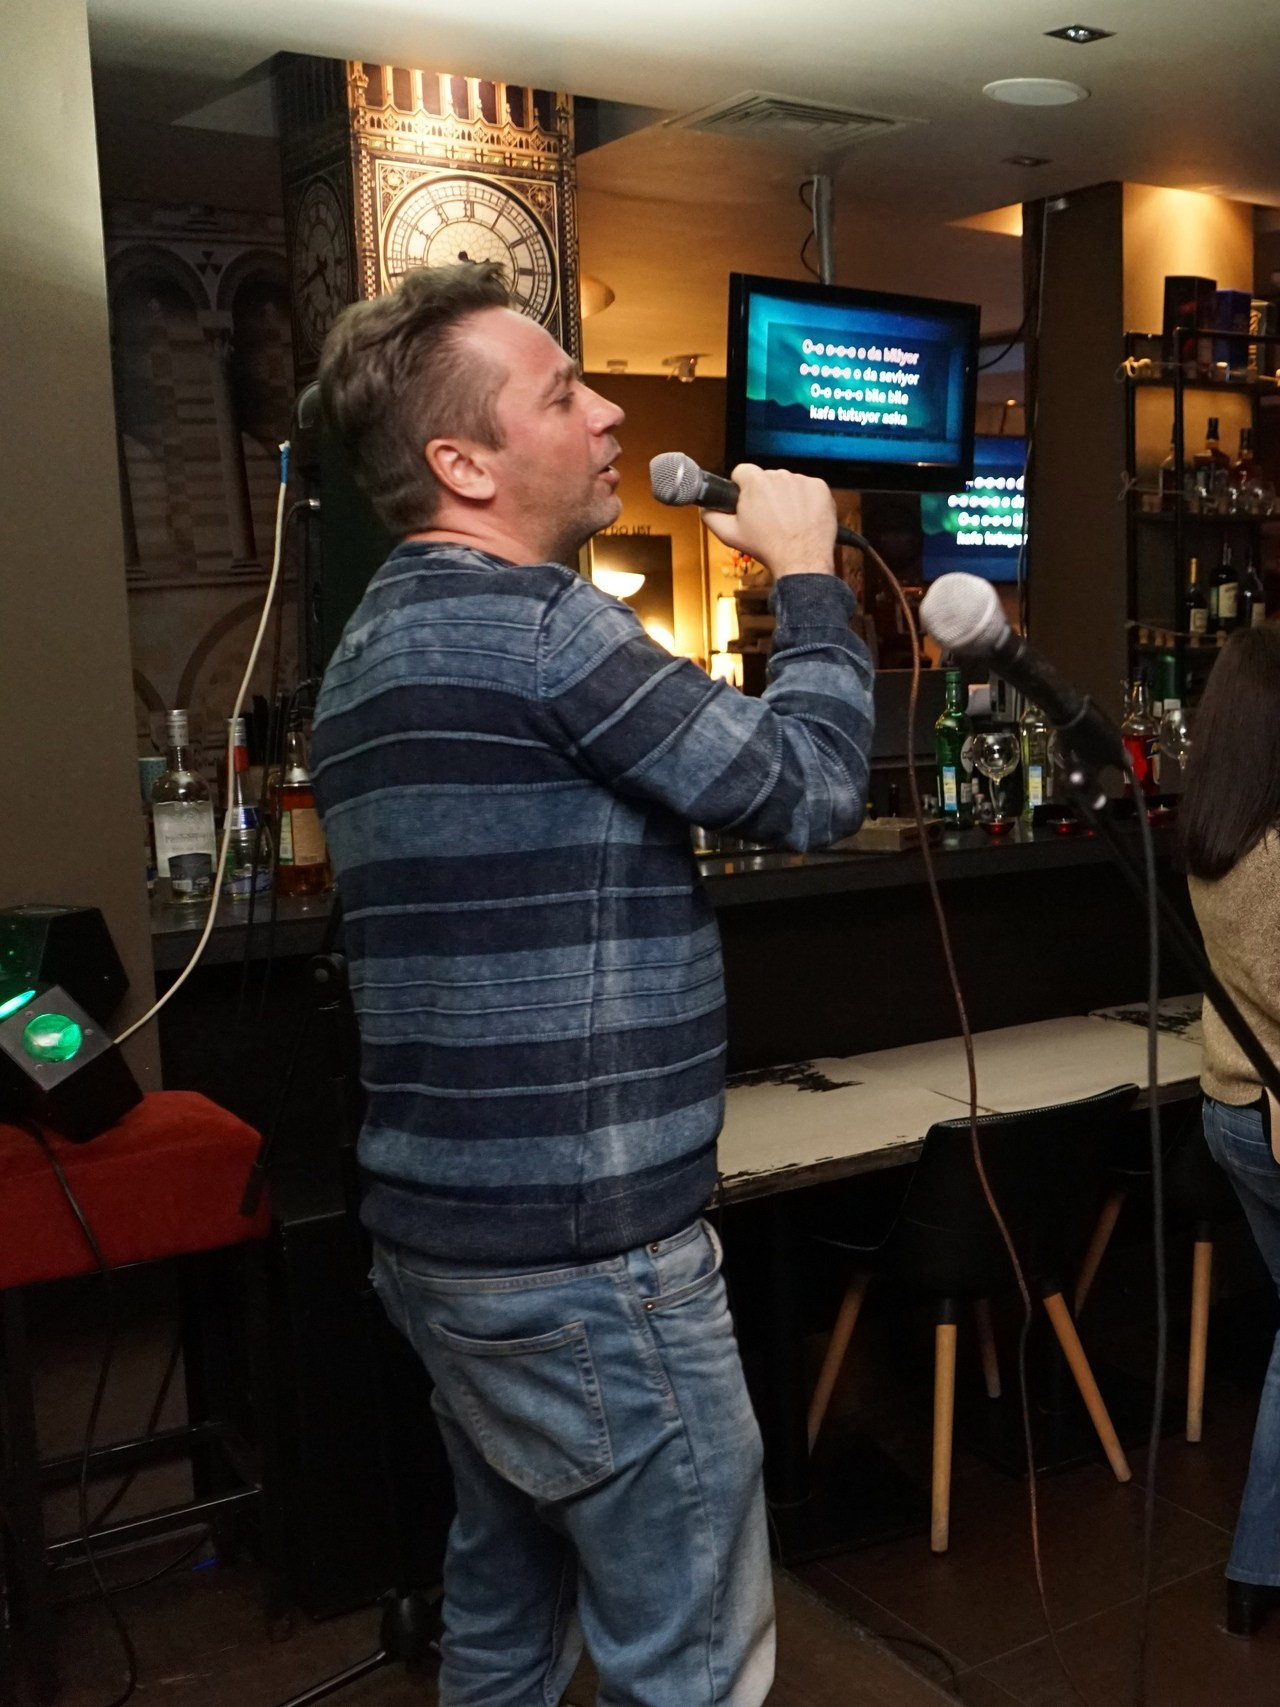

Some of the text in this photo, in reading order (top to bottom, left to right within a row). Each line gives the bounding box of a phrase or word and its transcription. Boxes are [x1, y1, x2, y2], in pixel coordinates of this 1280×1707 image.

[867, 346, 882, 361] da
[863, 367, 878, 382] da
[865, 387, 886, 403] bile
[888, 389, 909, 405] bile
[810, 405, 835, 420] kafa
[837, 406, 880, 426] tutuyor
